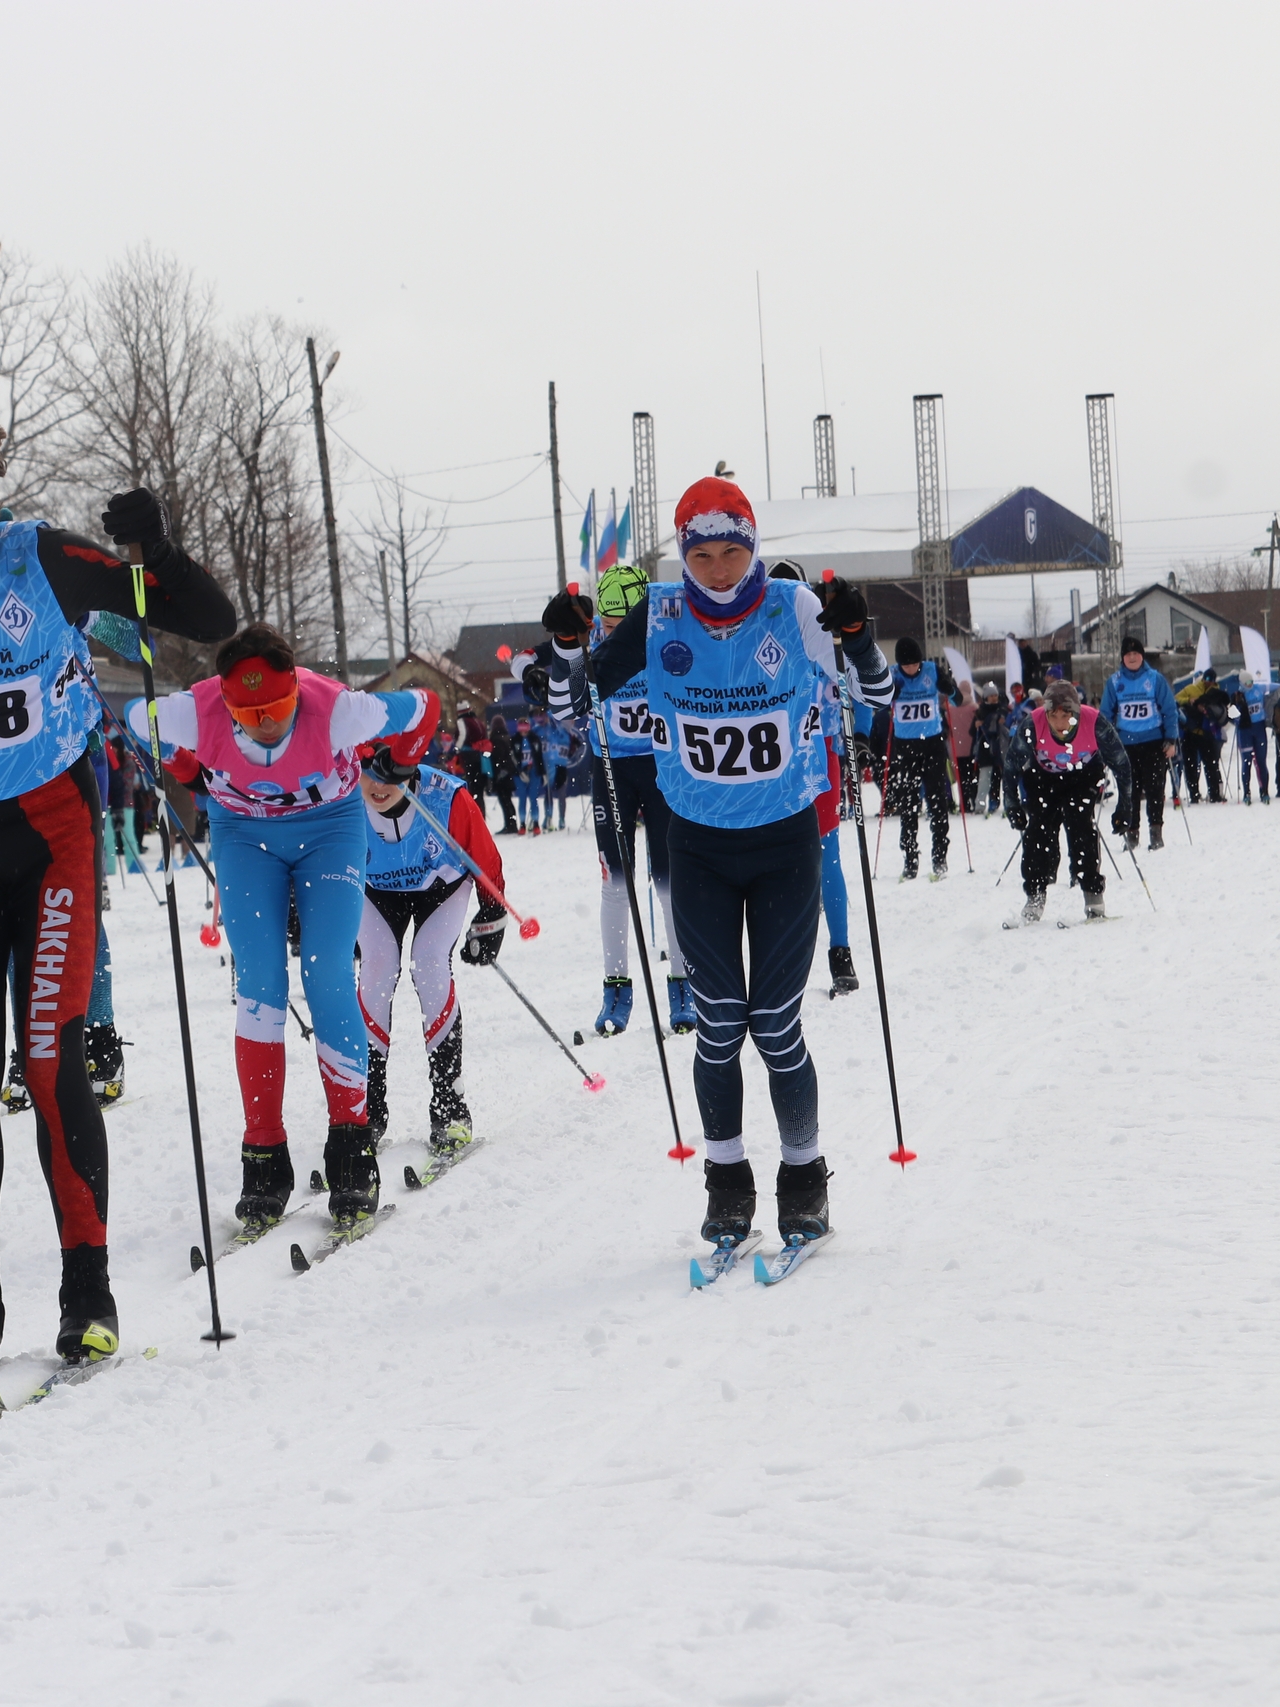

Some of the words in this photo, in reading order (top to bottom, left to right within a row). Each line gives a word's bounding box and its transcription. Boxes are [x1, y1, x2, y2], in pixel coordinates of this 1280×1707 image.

[685, 682, 768, 699] ТРОИЦКИЙ
[728, 685, 796, 712] МАРАФОН
[837, 672, 851, 708] KV+
[901, 702, 931, 720] 270
[1124, 703, 1148, 719] 275
[682, 721, 782, 777] 528
[601, 747, 623, 833] MARATHON
[846, 737, 864, 827] MARATHON
[29, 888, 74, 1059] SAKHALIN
